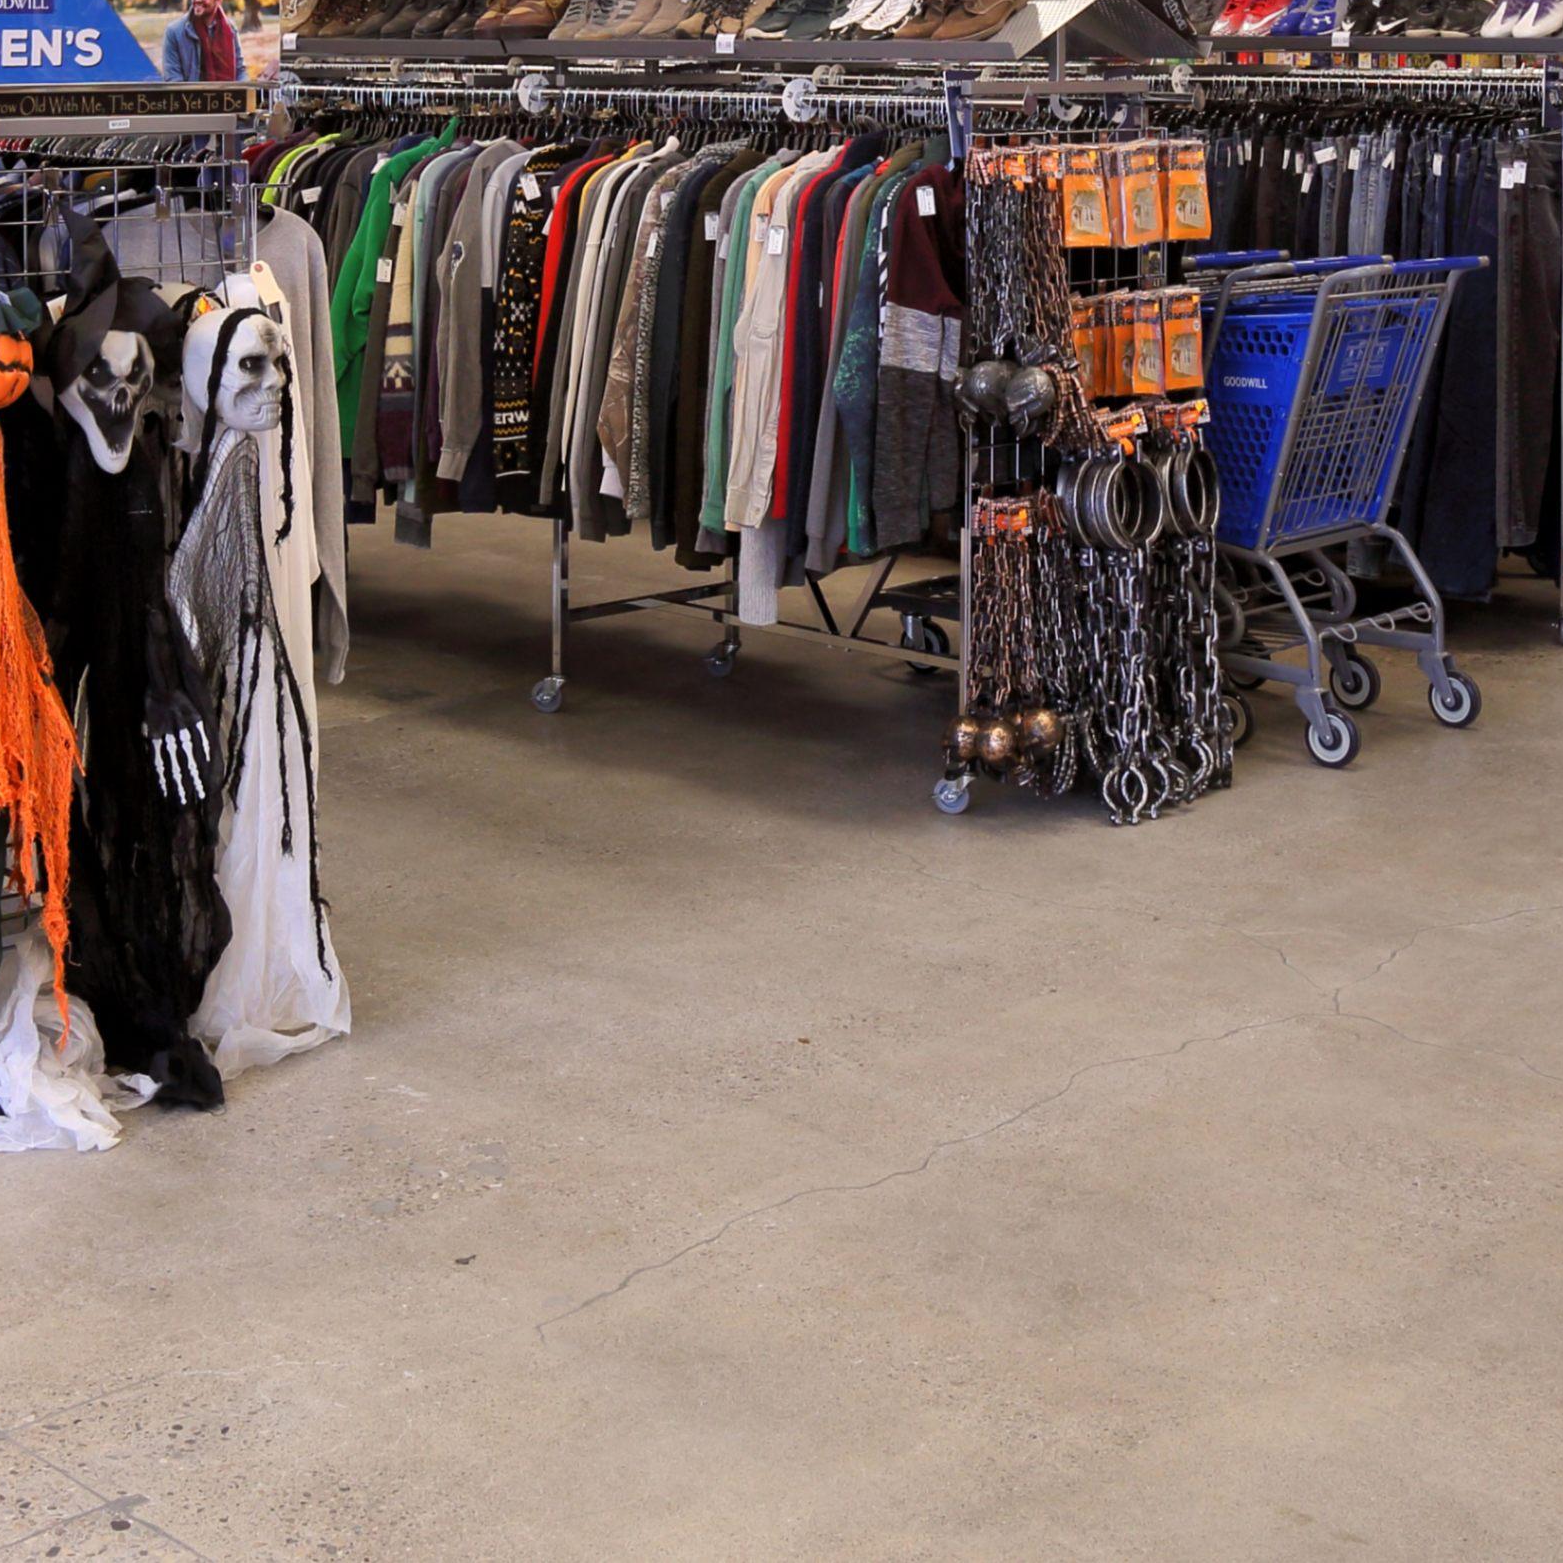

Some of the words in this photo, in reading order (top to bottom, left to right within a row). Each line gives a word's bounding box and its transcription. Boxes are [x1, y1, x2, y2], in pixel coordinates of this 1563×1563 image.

[20, 95, 46, 116] Old
[49, 95, 79, 114] With
[108, 94, 135, 114] The
[137, 94, 168, 114] Best
[170, 93, 180, 112] Is
[181, 93, 202, 111] Yet
[204, 93, 219, 111] To
[223, 92, 243, 111] Be
[1223, 375, 1268, 389] GOODWILL
